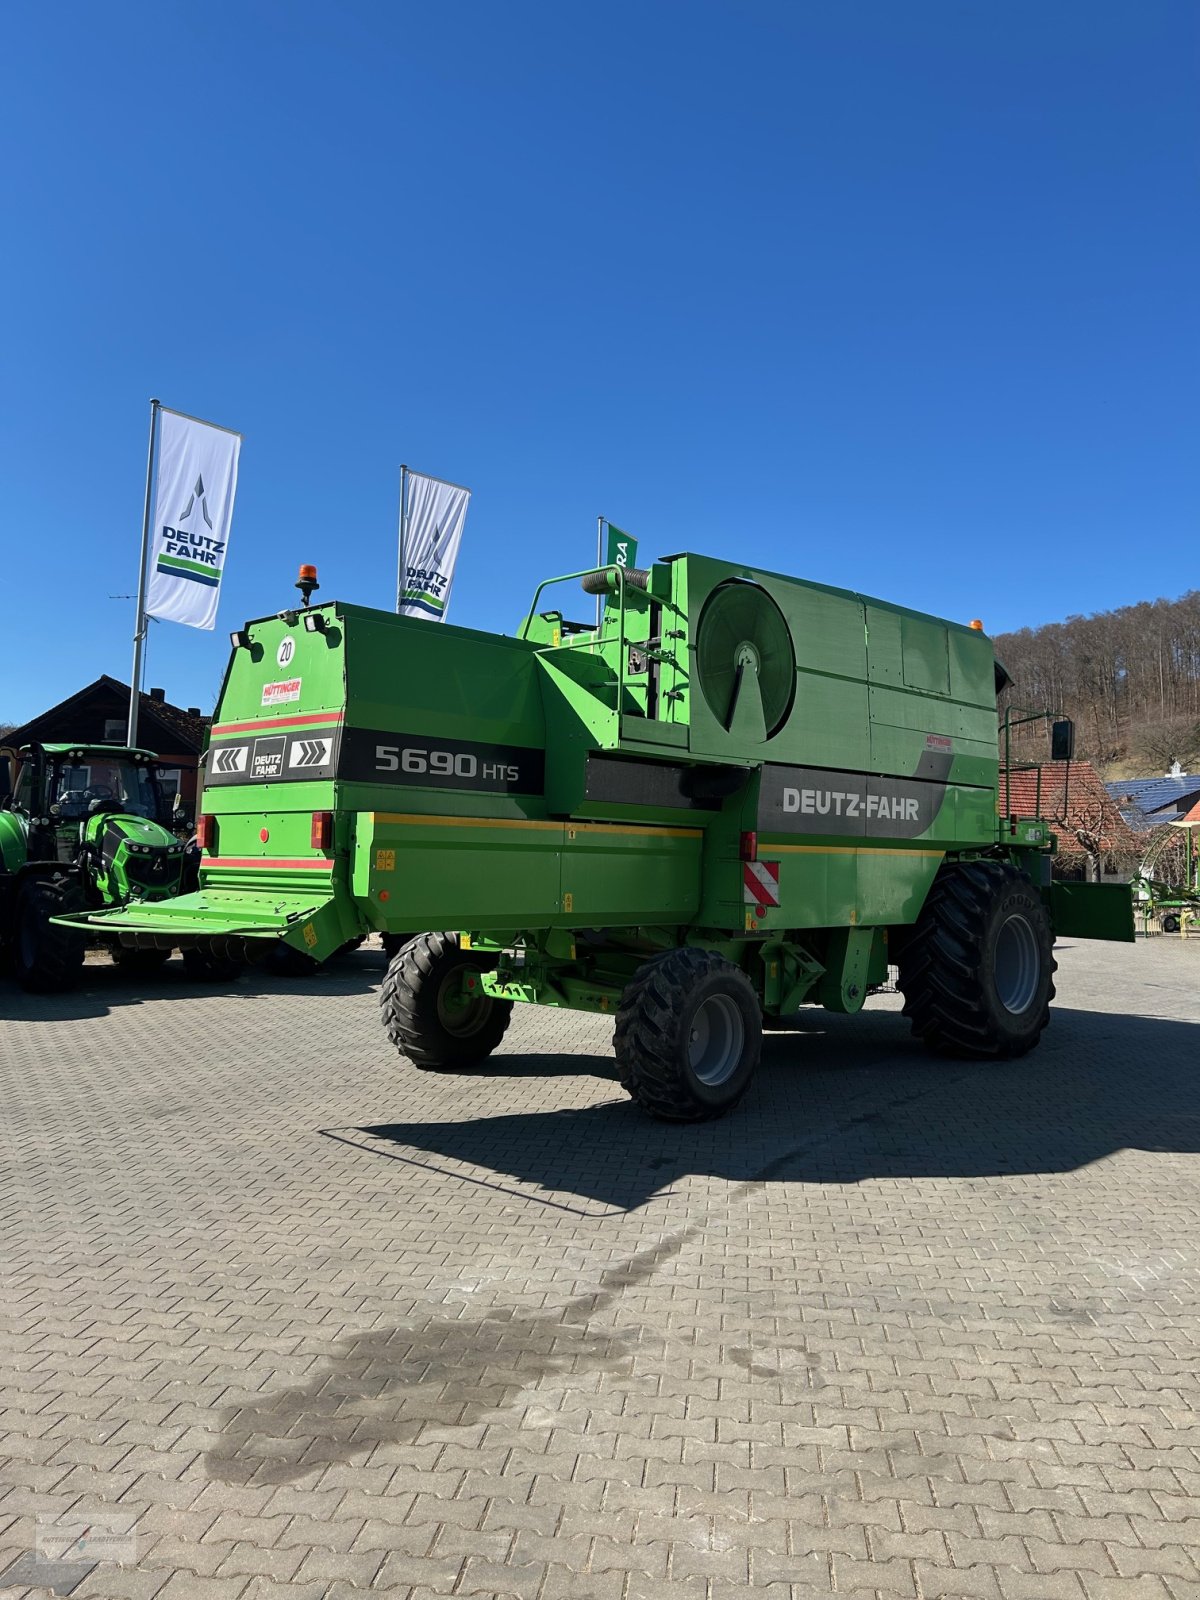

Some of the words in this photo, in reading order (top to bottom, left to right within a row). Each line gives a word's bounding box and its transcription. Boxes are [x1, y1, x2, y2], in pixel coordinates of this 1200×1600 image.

[162, 526, 225, 553] DEUTZ
[166, 541, 216, 565] FAHR
[407, 567, 448, 588] DEUTZ
[408, 580, 441, 598] FAHR
[280, 642, 292, 662] 20
[254, 754, 281, 765] DEUTZ
[255, 765, 278, 775] FAHR
[375, 745, 478, 778] 5690
[482, 764, 519, 781] HTS
[783, 788, 919, 820] DEUTZ-FAHR
